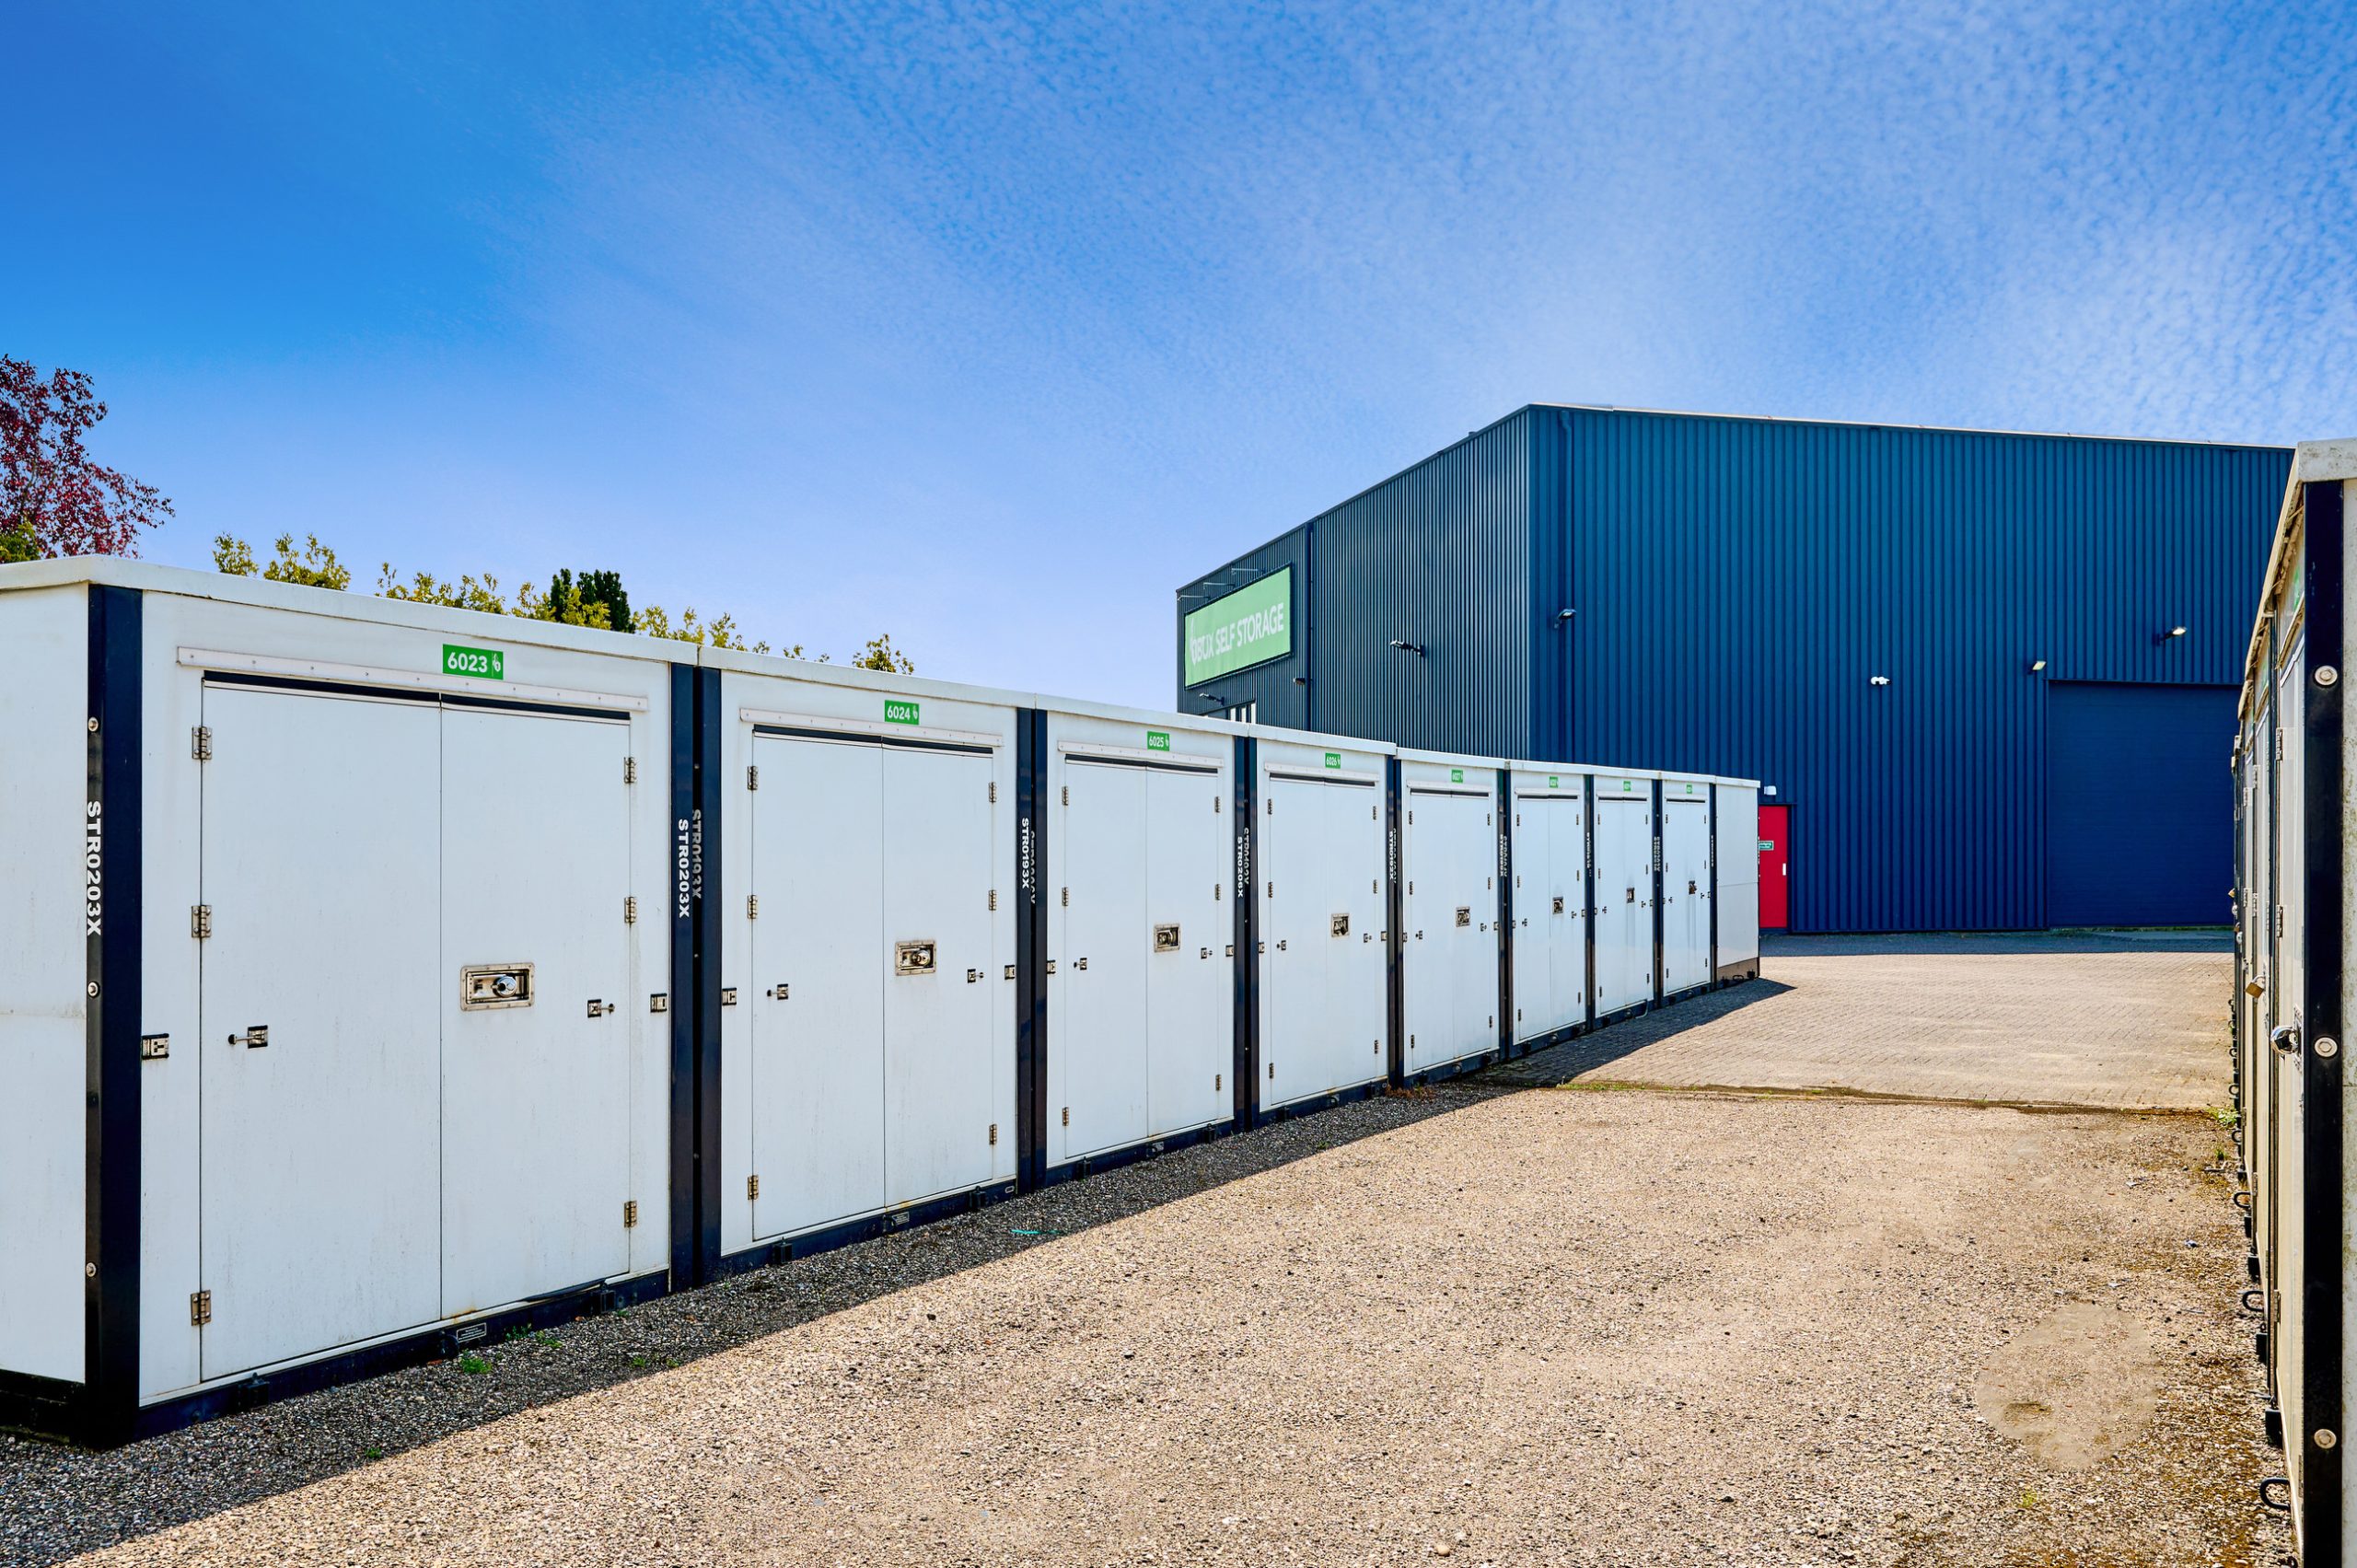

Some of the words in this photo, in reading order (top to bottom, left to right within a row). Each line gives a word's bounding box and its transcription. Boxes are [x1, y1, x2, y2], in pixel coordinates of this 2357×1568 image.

[1215, 623, 1236, 655] SELF
[1237, 603, 1284, 647] STORAGE
[447, 651, 488, 673] 6023
[887, 705, 911, 721] 6024
[1148, 736, 1165, 748] 6025
[87, 800, 101, 936] STR0203X
[679, 819, 690, 918] STR0203X
[1021, 818, 1029, 889] STR0193X
